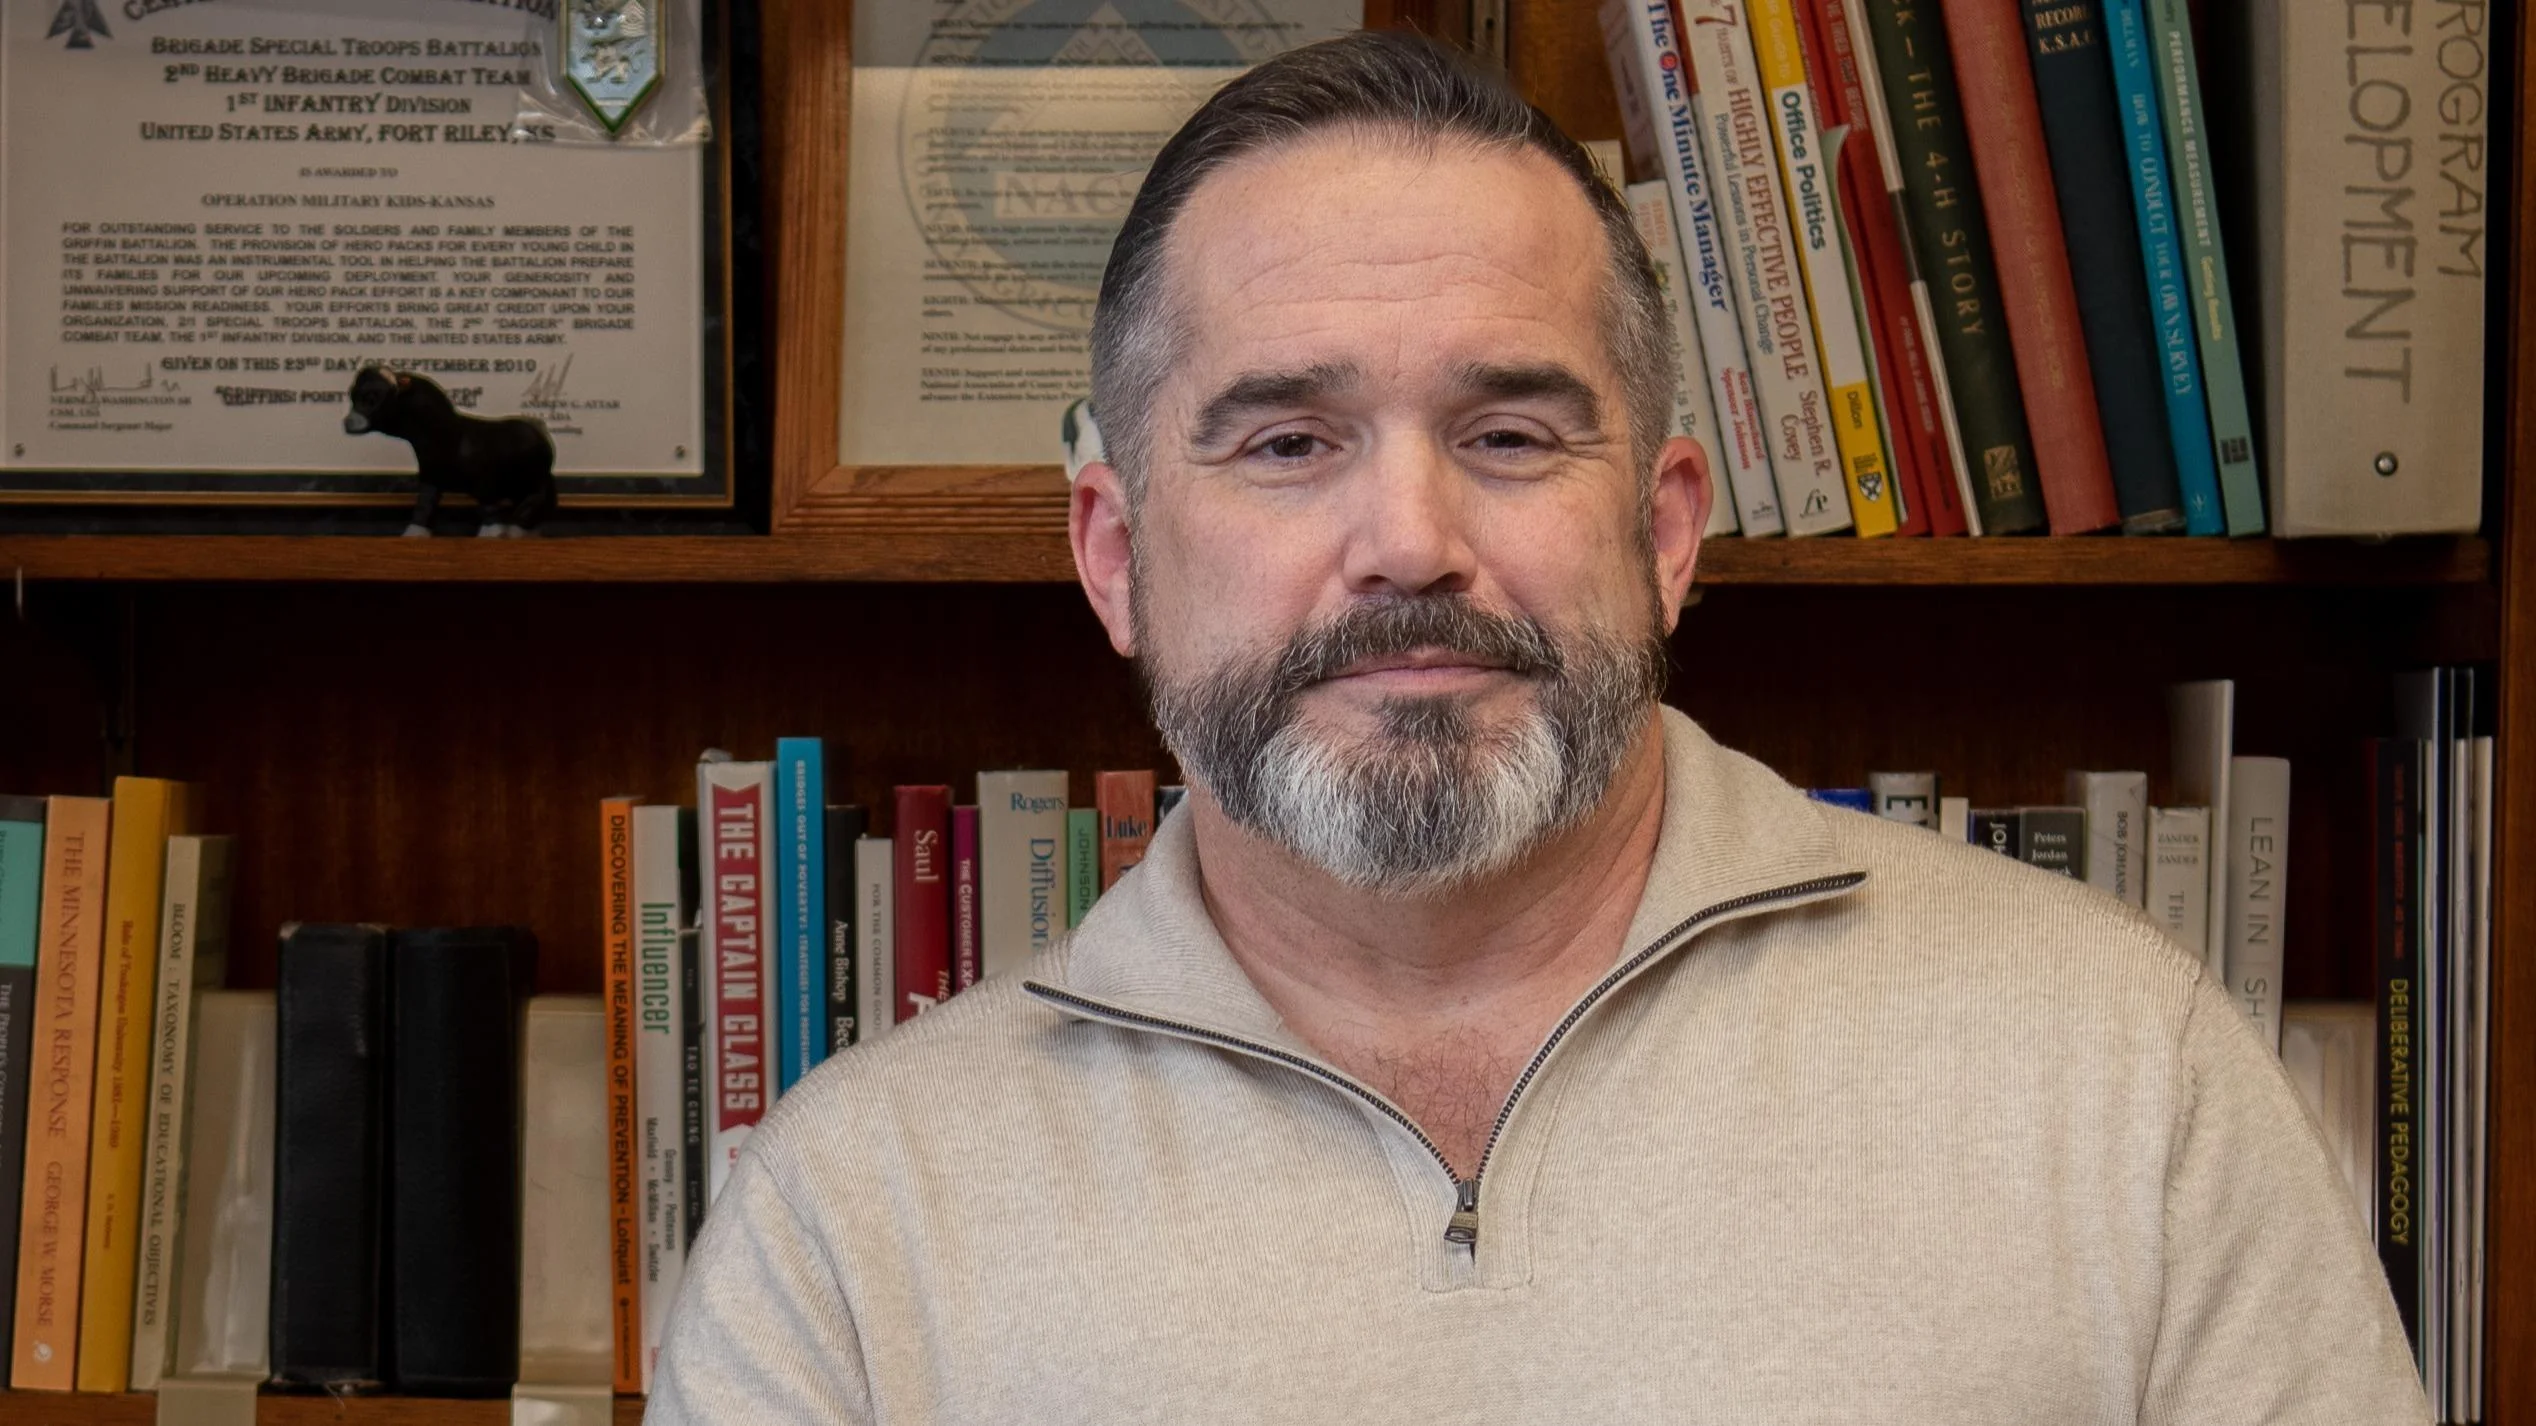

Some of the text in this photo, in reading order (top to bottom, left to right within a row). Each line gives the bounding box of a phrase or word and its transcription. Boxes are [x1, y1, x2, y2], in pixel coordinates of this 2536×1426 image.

[151, 36, 542, 58] BRIGADE SPECIAL TROOPS BATTALION
[1694, 4, 1738, 27] 7
[205, 65, 278, 84] HEAVY
[282, 65, 375, 85] BRIGADE
[380, 66, 467, 86] COMBAT
[471, 67, 532, 86] TEAM
[263, 93, 381, 113] INFANTRY
[386, 96, 472, 114] DIVISION
[139, 121, 214, 141] UNITED
[218, 121, 299, 142] STATES
[379, 123, 439, 142] FORT
[1647, 1, 1729, 312] The One Minute Manager
[1728, 88, 1767, 168] HIGHLY
[2168, 30, 2196, 134] PERFORMANCE
[2184, 139, 2212, 247] MEASUREMENT
[200, 193, 496, 209] OPERATION MILITARY KIDS-KANSAS
[1781, 91, 1809, 158] Office
[1796, 163, 1827, 251] Politics
[1907, 67, 1986, 337] THE 4-H STORY
[61, 223, 634, 238] FOR OUTSTANDING SERVICE TO THE SOLDIERS AND FAMILY MEMBERS OF THE
[62, 239, 116, 252] GRIFFIN
[211, 239, 236, 252] THE
[241, 239, 316, 252] PROVISION
[320, 239, 338, 252] OF
[343, 240, 383, 253] HERO
[387, 240, 433, 253] PACKS
[438, 240, 466, 253] FOR
[471, 240, 514, 253] EVERY
[521, 240, 569, 253] YOUNG
[574, 240, 616, 253] CHILD
[619, 240, 634, 253] IN
[1715, 112, 1775, 355] Powerful Lessons in Personal Change
[1743, 175, 1790, 291] EFFECTIVE
[2132, 93, 2193, 396] HOW TO CONDUCT YOUR OWN SURVEY
[60, 332, 119, 345] COMBAT
[169, 332, 196, 345] THE
[220, 332, 287, 345] INFANTRY
[355, 333, 386, 346] AND
[389, 333, 416, 346] THE
[418, 333, 470, 346] UNITED
[471, 333, 522, 346] STATES
[161, 356, 537, 373] GIVEN ON THIS DAY SEPTEMBER 2010
[1771, 295, 1809, 380] PEOPLE
[1720, 368, 1752, 470] Spencer Johnson
[1780, 413, 1802, 462] Covey
[1799, 389, 1827, 457] Stephen
[795, 760, 808, 810] BRIDGES
[1010, 791, 1067, 815] Rogers
[796, 814, 808, 840] OUT
[797, 843, 808, 860] OF
[913, 829, 939, 884] Saul
[1105, 814, 1149, 840] Luke
[2033, 832, 2067, 844] Peters
[2156, 853, 2200, 865] ZANDER
[2157, 832, 2201, 844] ZANDER
[610, 814, 628, 935] DISCOVERING
[1077, 827, 1092, 912] JOHNSON
[2247, 816, 2274, 945] LEAN IN
[871, 883, 883, 997] FOR THE COMMON
[960, 884, 972, 956] CUSTOMER
[611, 939, 628, 975] THE
[641, 902, 678, 1035] Influencer
[719, 803, 760, 1111] THE CAPTAIN CLASS
[832, 919, 850, 1001] Anne Bishop
[612, 979, 629, 1059] MEANING
[2389, 978, 2409, 1115] DELIBERATIVE
[38, 831, 86, 1327] THE MINNESOTA RESPONSE GEORGE MORSE
[615, 1064, 629, 1086] OF
[144, 902, 186, 1326] BLOOM TAXONOMY OF EDUCATIONAL OBJECTIVES
[615, 1094, 631, 1203] PREVENTION
[2389, 1121, 2409, 1245] PEDAGOGY
